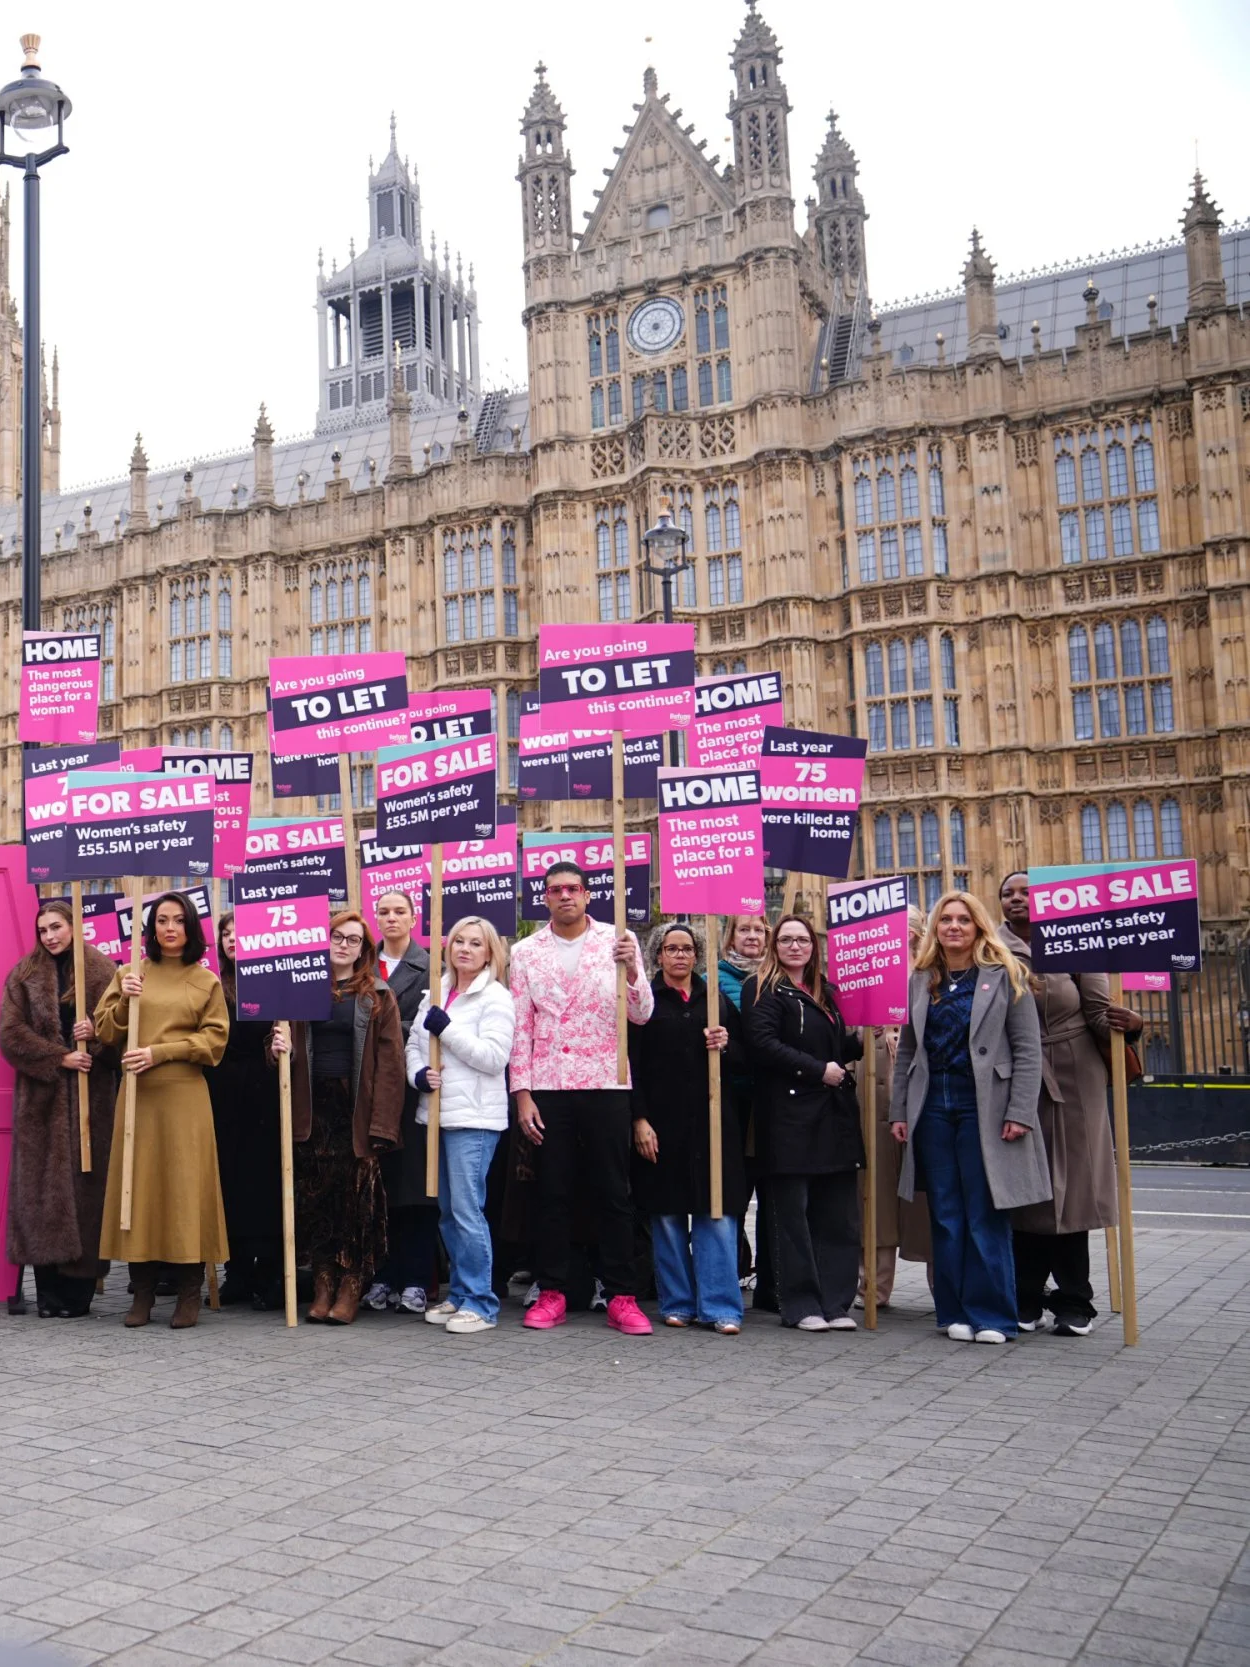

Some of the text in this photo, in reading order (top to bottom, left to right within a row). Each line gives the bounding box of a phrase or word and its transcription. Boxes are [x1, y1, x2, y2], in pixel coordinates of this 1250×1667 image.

[25, 638, 98, 661] HOME
[545, 640, 647, 661] Are you going
[28, 668, 82, 680] The most
[275, 669, 364, 692] Are you going
[562, 659, 670, 694] TO LET
[29, 680, 93, 693] dangerous
[30, 694, 61, 706] place
[64, 691, 81, 701] for
[291, 685, 386, 721] TO LET
[588, 691, 690, 714] this continue?
[30, 705, 74, 715] woman
[317, 713, 406, 739] this continue?
[771, 740, 833, 754] Last year
[381, 743, 492, 791] FOR SALE
[795, 763, 826, 782] 75
[72, 783, 210, 816] FOR SALE
[384, 784, 473, 813] Women's safety
[662, 775, 758, 807] HOME
[761, 786, 855, 802] women
[387, 800, 479, 829] £55.5M per year
[667, 814, 739, 831] The most
[794, 813, 849, 825] killed at
[76, 820, 186, 839] Women's safety
[671, 831, 755, 847] dangerous
[811, 827, 850, 838] home
[78, 837, 193, 856] £55.5M per year
[673, 846, 754, 866] place for a
[675, 864, 733, 878] woman
[241, 885, 297, 899] Last year
[830, 882, 905, 923] HOME
[1034, 870, 1192, 914] FOR SALE
[267, 905, 297, 927] 75
[1040, 912, 1165, 937] Women's safety
[239, 927, 326, 951] women
[834, 924, 889, 946] The most
[1045, 929, 1175, 955] £55.5M per year
[836, 938, 901, 964] dangerous
[240, 955, 325, 975] were killed at
[838, 955, 900, 980] place for a
[292, 971, 327, 982] home
[839, 975, 883, 992] woman
